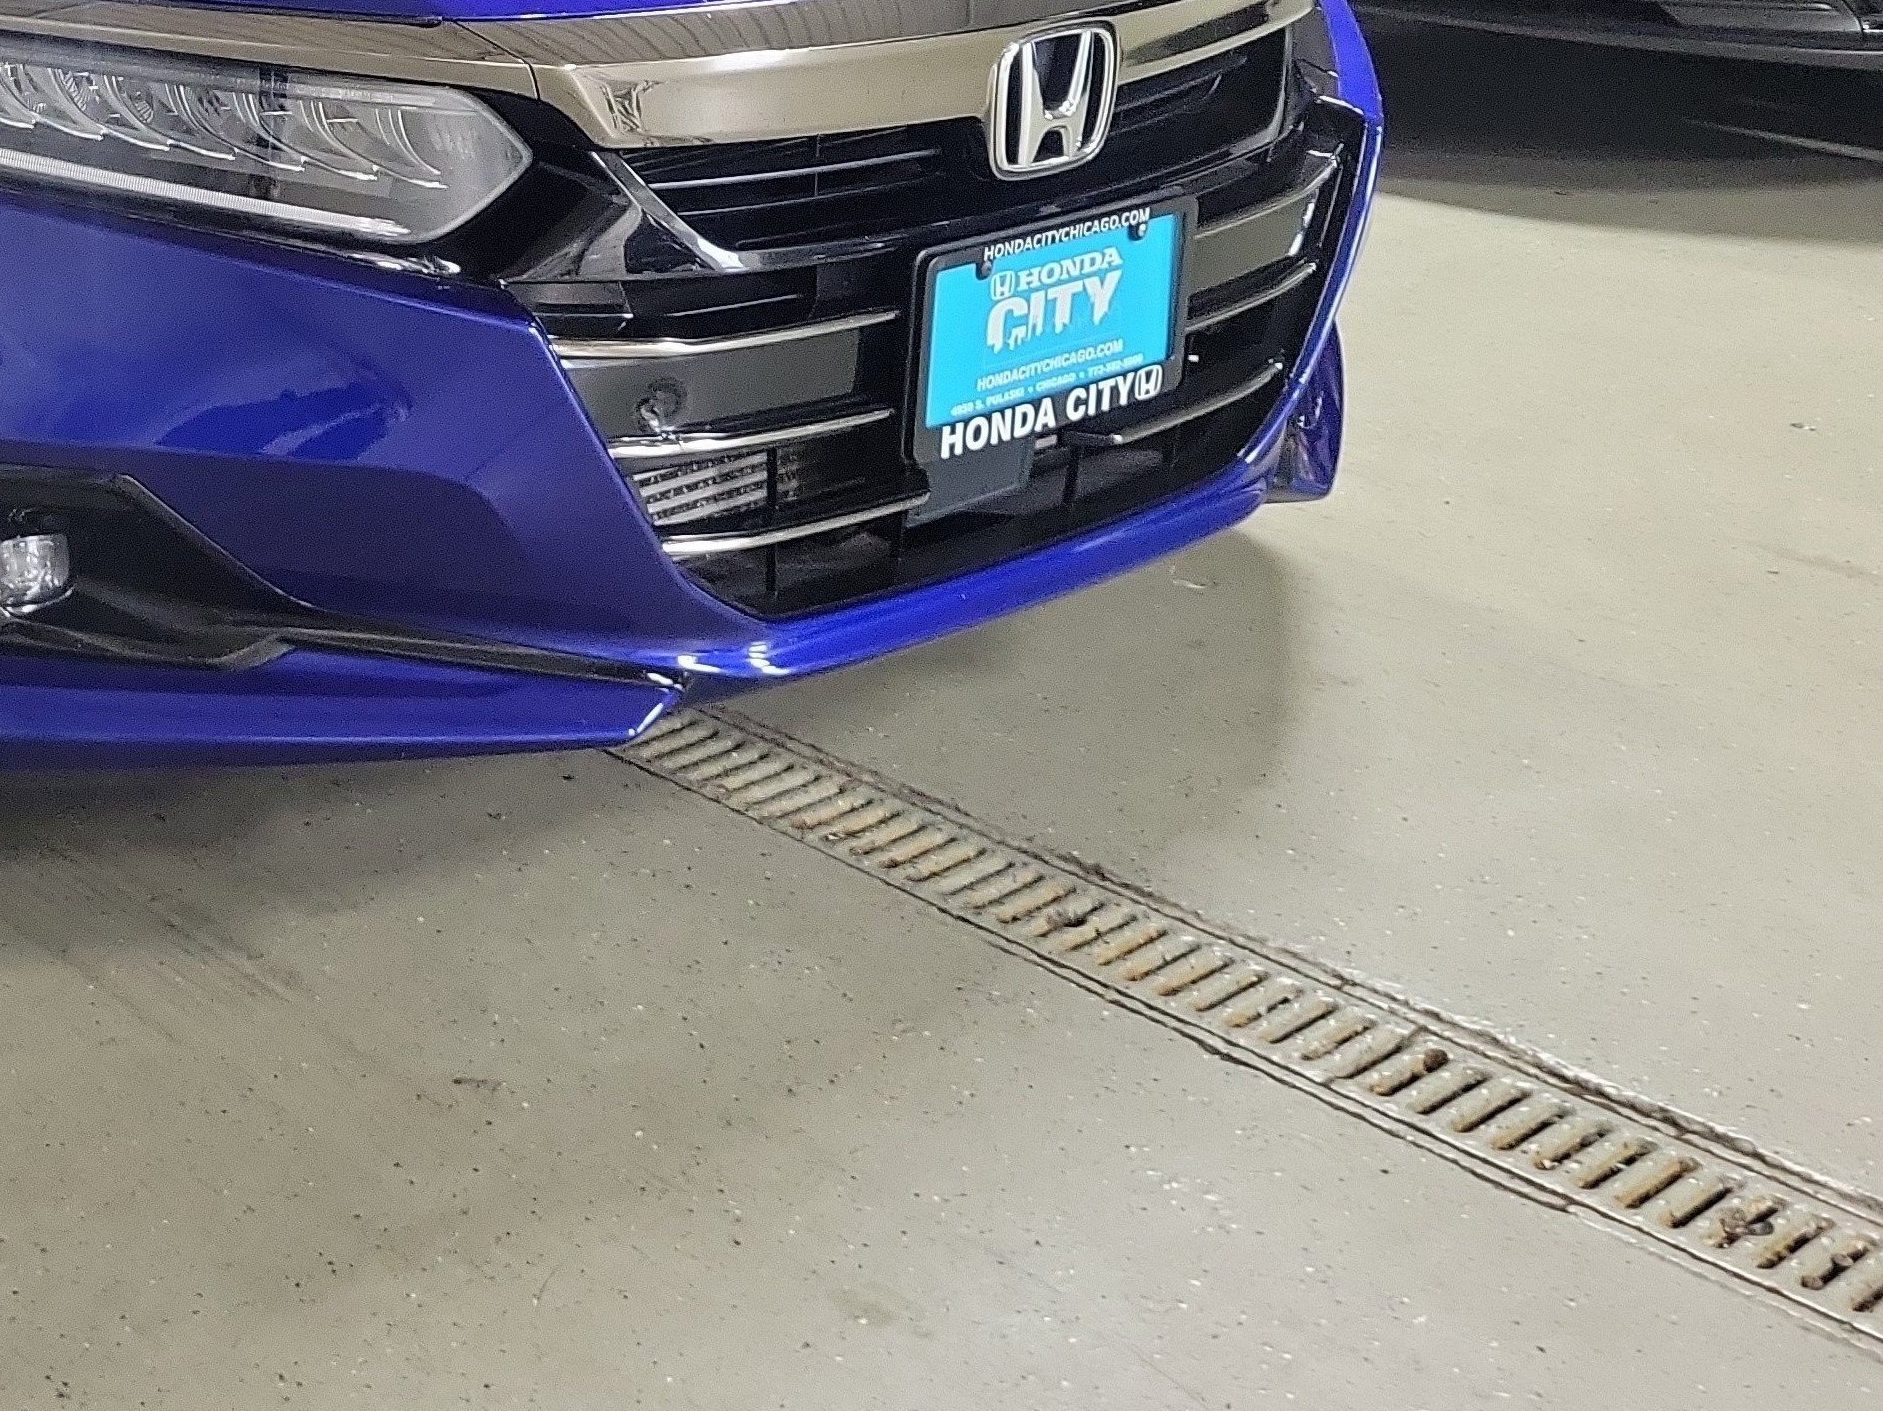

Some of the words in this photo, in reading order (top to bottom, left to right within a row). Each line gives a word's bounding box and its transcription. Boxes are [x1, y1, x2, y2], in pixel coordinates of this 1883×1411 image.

[983, 207, 1151, 262] HONDACITYCHICAGO.COM
[1017, 246, 1124, 291] HONDA
[986, 268, 1123, 355] CITY
[976, 338, 1124, 392] HONDACITYCHICAGO.COM
[940, 397, 1057, 459] HONDA
[1066, 371, 1136, 422] CITY
